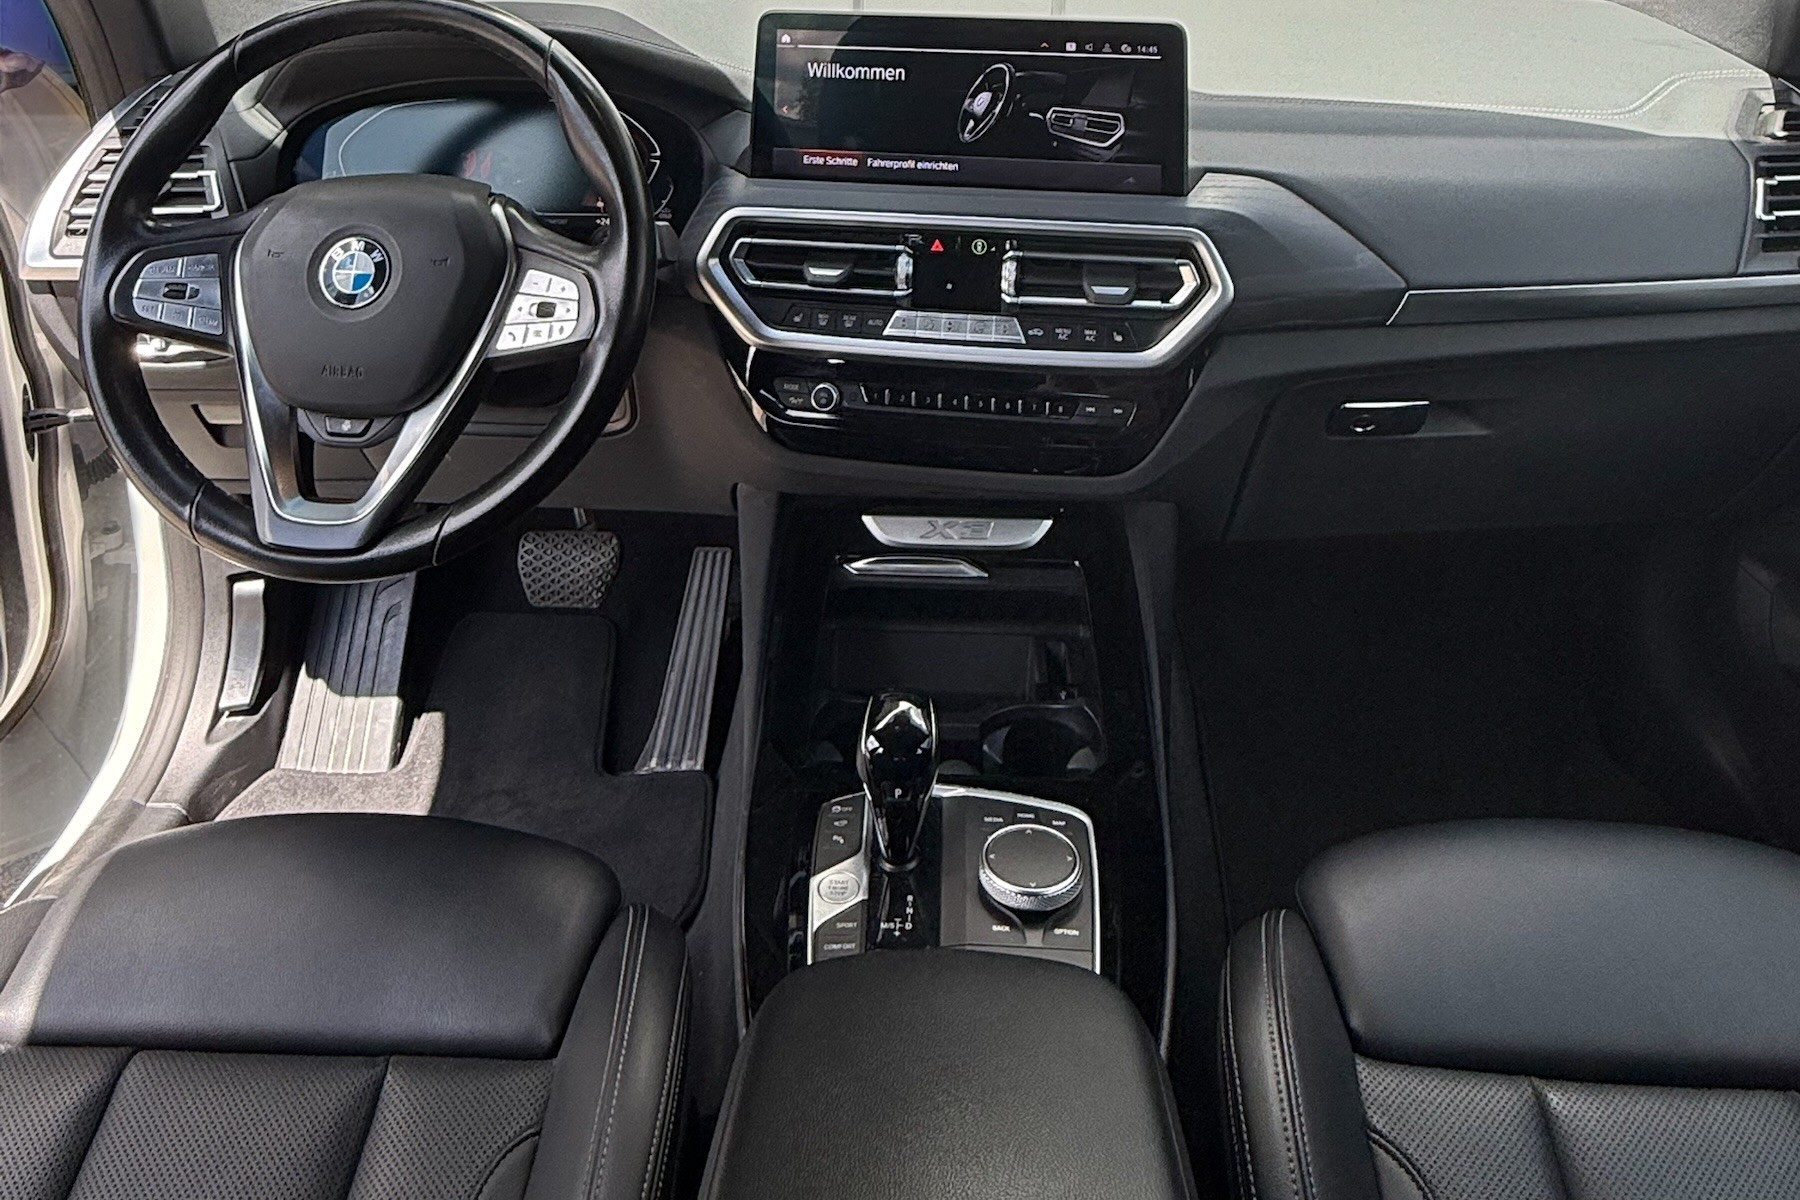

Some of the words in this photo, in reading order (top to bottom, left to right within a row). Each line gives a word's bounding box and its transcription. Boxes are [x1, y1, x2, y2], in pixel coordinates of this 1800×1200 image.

[1137, 45, 1158, 54] 14:45
[807, 62, 906, 81] Willkommen
[802, 155, 825, 165] Erste
[826, 156, 859, 167] Schritte
[867, 157, 916, 170] Fahrerprofil
[916, 160, 959, 171] einrichten
[330, 240, 385, 263] BMW
[320, 364, 365, 379] AIRBAG
[920, 519, 995, 540] X3
[894, 788, 903, 799] P
[904, 921, 913, 930] D
[991, 924, 1011, 932] BACK
[1053, 928, 1080, 936] OPTION
[823, 943, 856, 951] COMFORT
